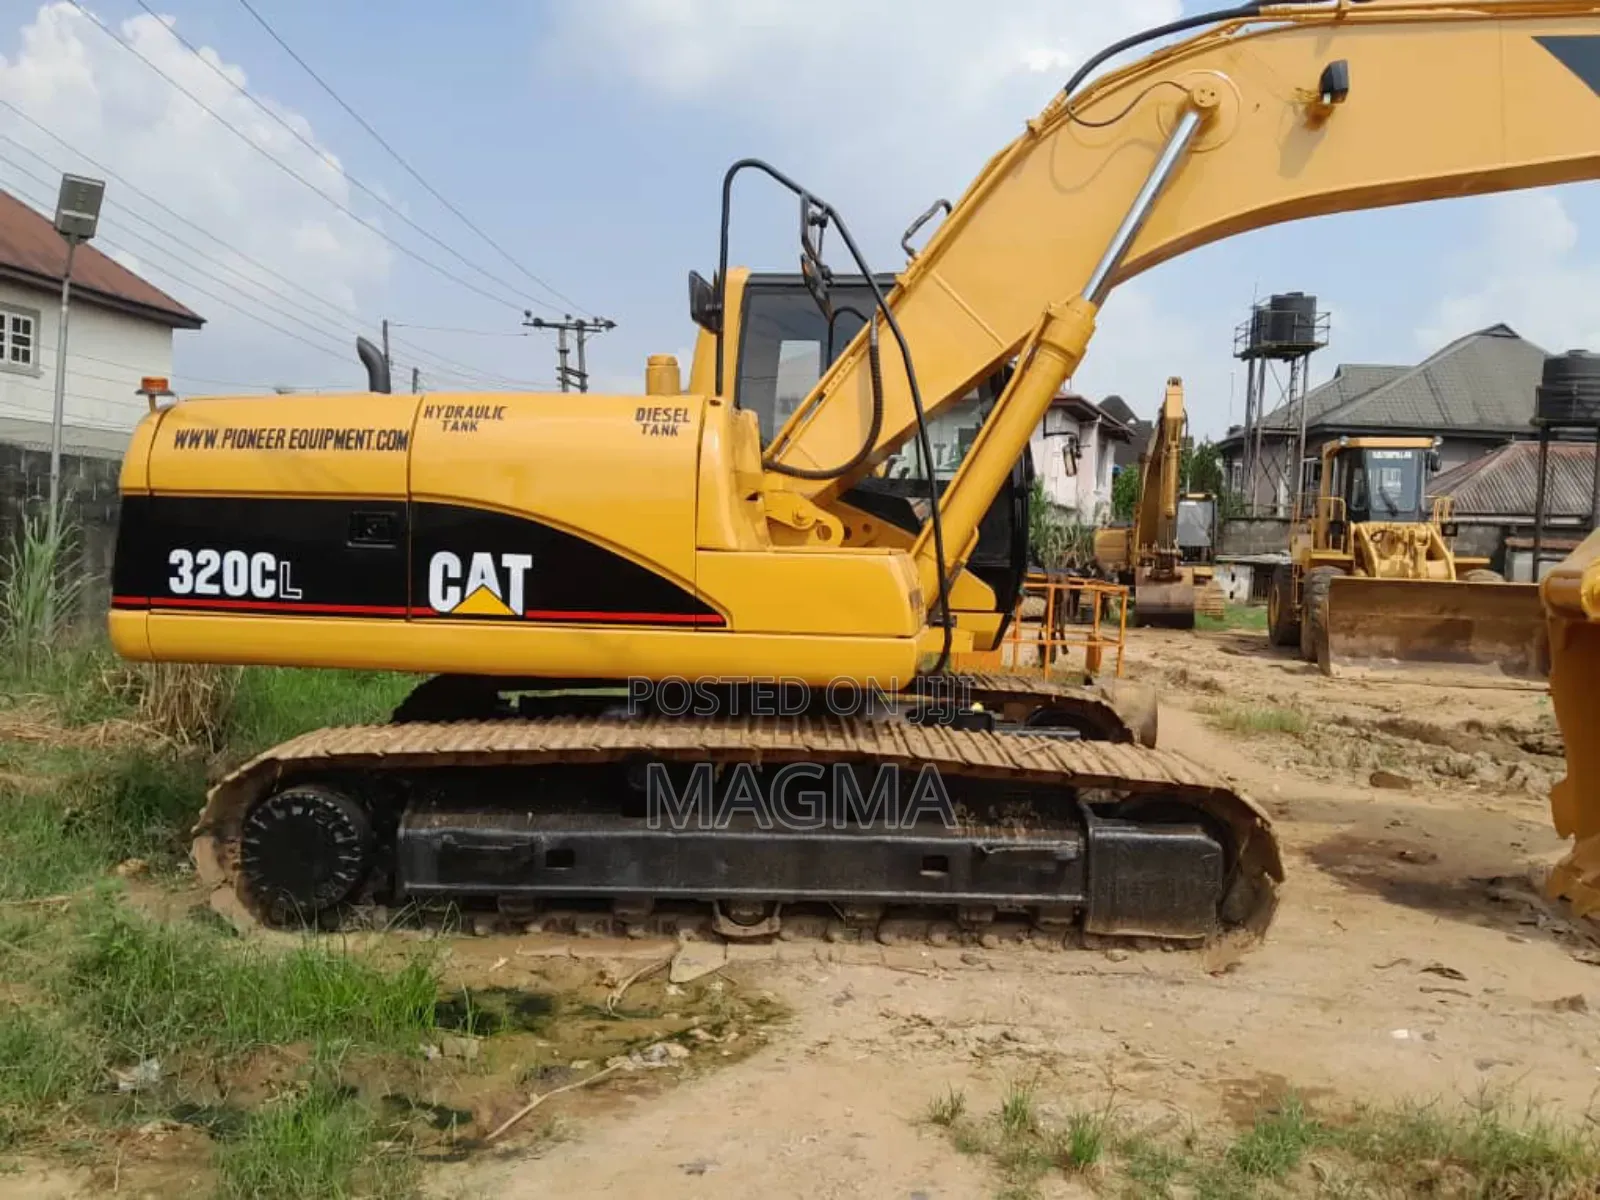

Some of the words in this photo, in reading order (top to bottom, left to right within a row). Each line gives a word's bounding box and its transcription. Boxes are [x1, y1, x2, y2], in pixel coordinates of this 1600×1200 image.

[424, 405, 508, 420] HYDRAULIC
[635, 407, 690, 423] DIESEL
[441, 420, 479, 432] TANK
[641, 423, 679, 437] TANK
[428, 551, 533, 615] CAT
